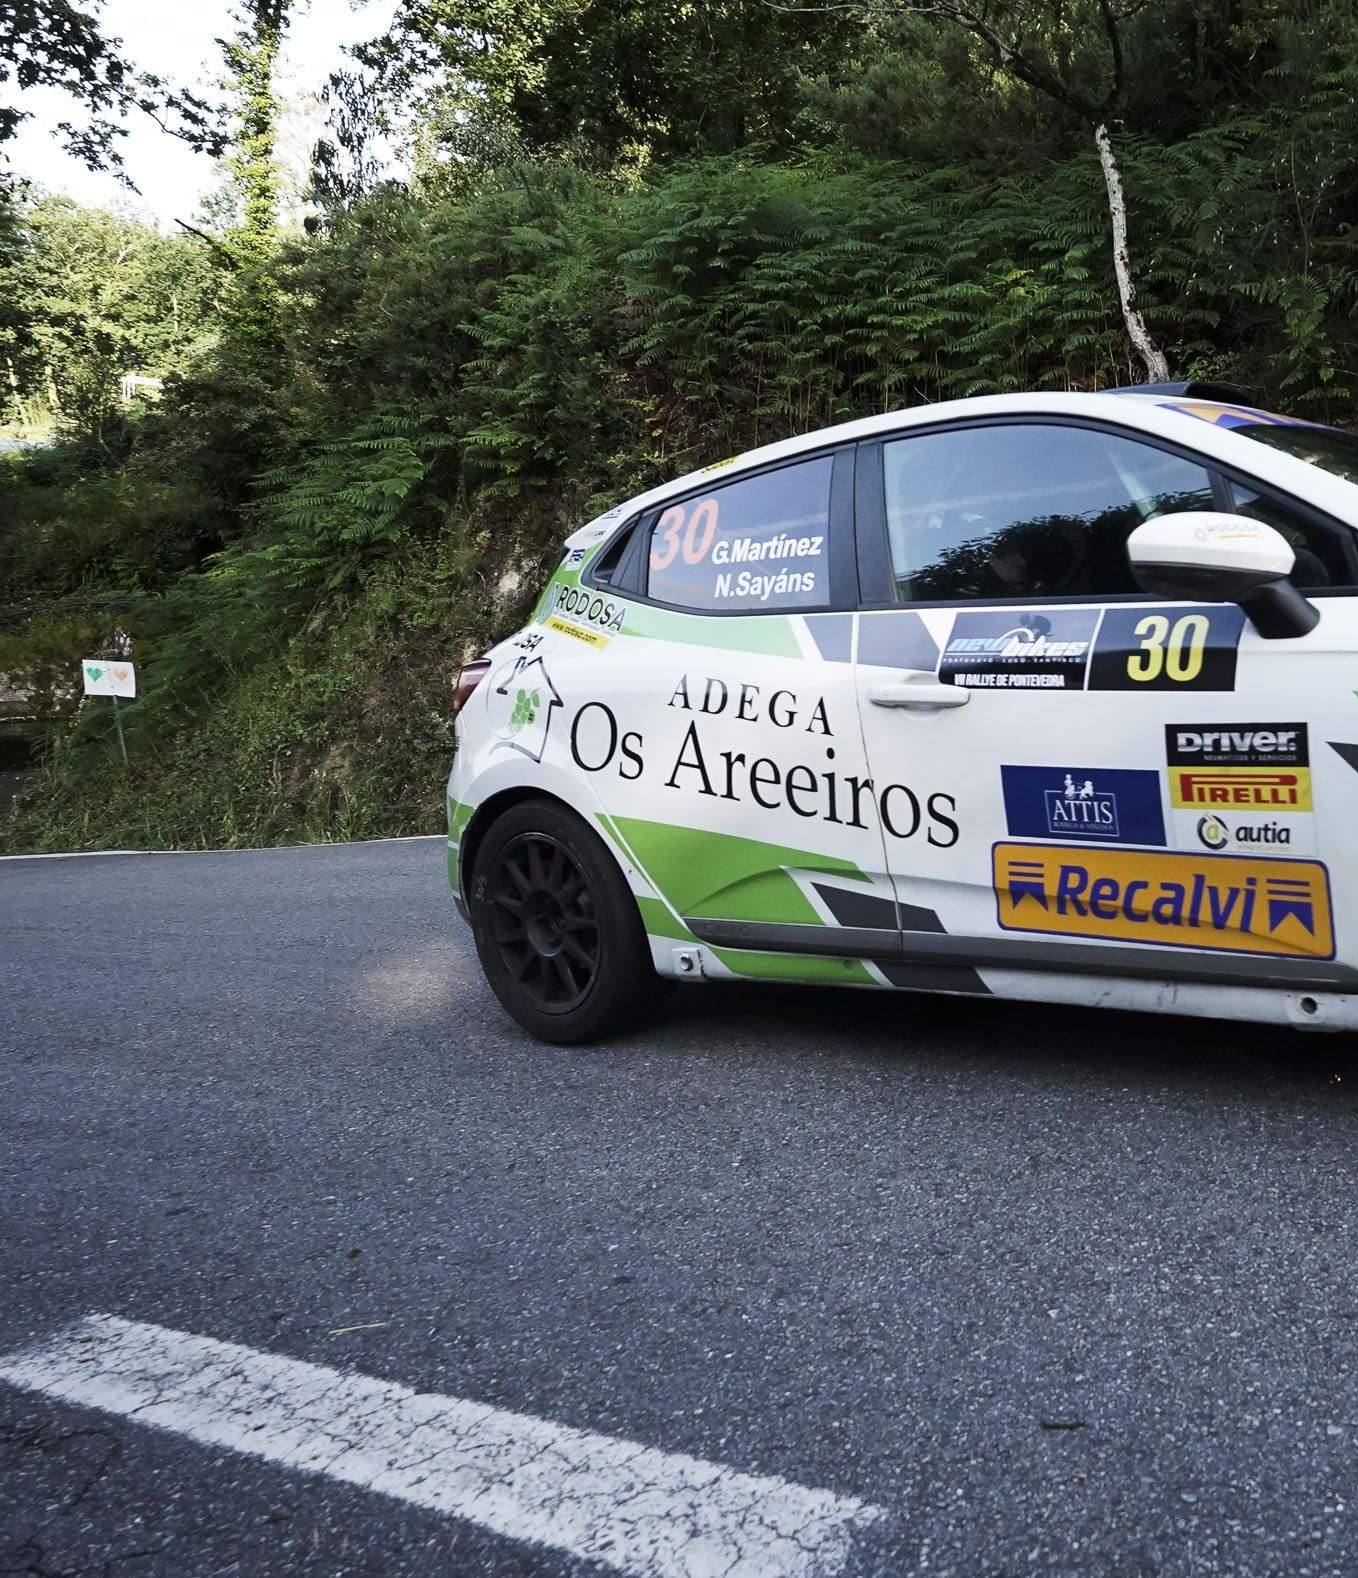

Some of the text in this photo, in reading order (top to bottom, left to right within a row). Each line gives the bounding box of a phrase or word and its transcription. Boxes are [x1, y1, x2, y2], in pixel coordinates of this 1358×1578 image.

[650, 499, 719, 570] 30
[711, 534, 824, 565] G.Martínez
[714, 568, 815, 601] N.Sayáns
[555, 586, 627, 632] RODOSA
[1126, 614, 1210, 682] 30
[668, 674, 835, 737] ADEGA
[570, 701, 960, 848] Os Areeiros
[1180, 773, 1298, 805] PIRELLI
[1053, 799, 1114, 824] ATTIS
[1235, 821, 1291, 844] autia
[1056, 864, 1258, 932] Recalvi
